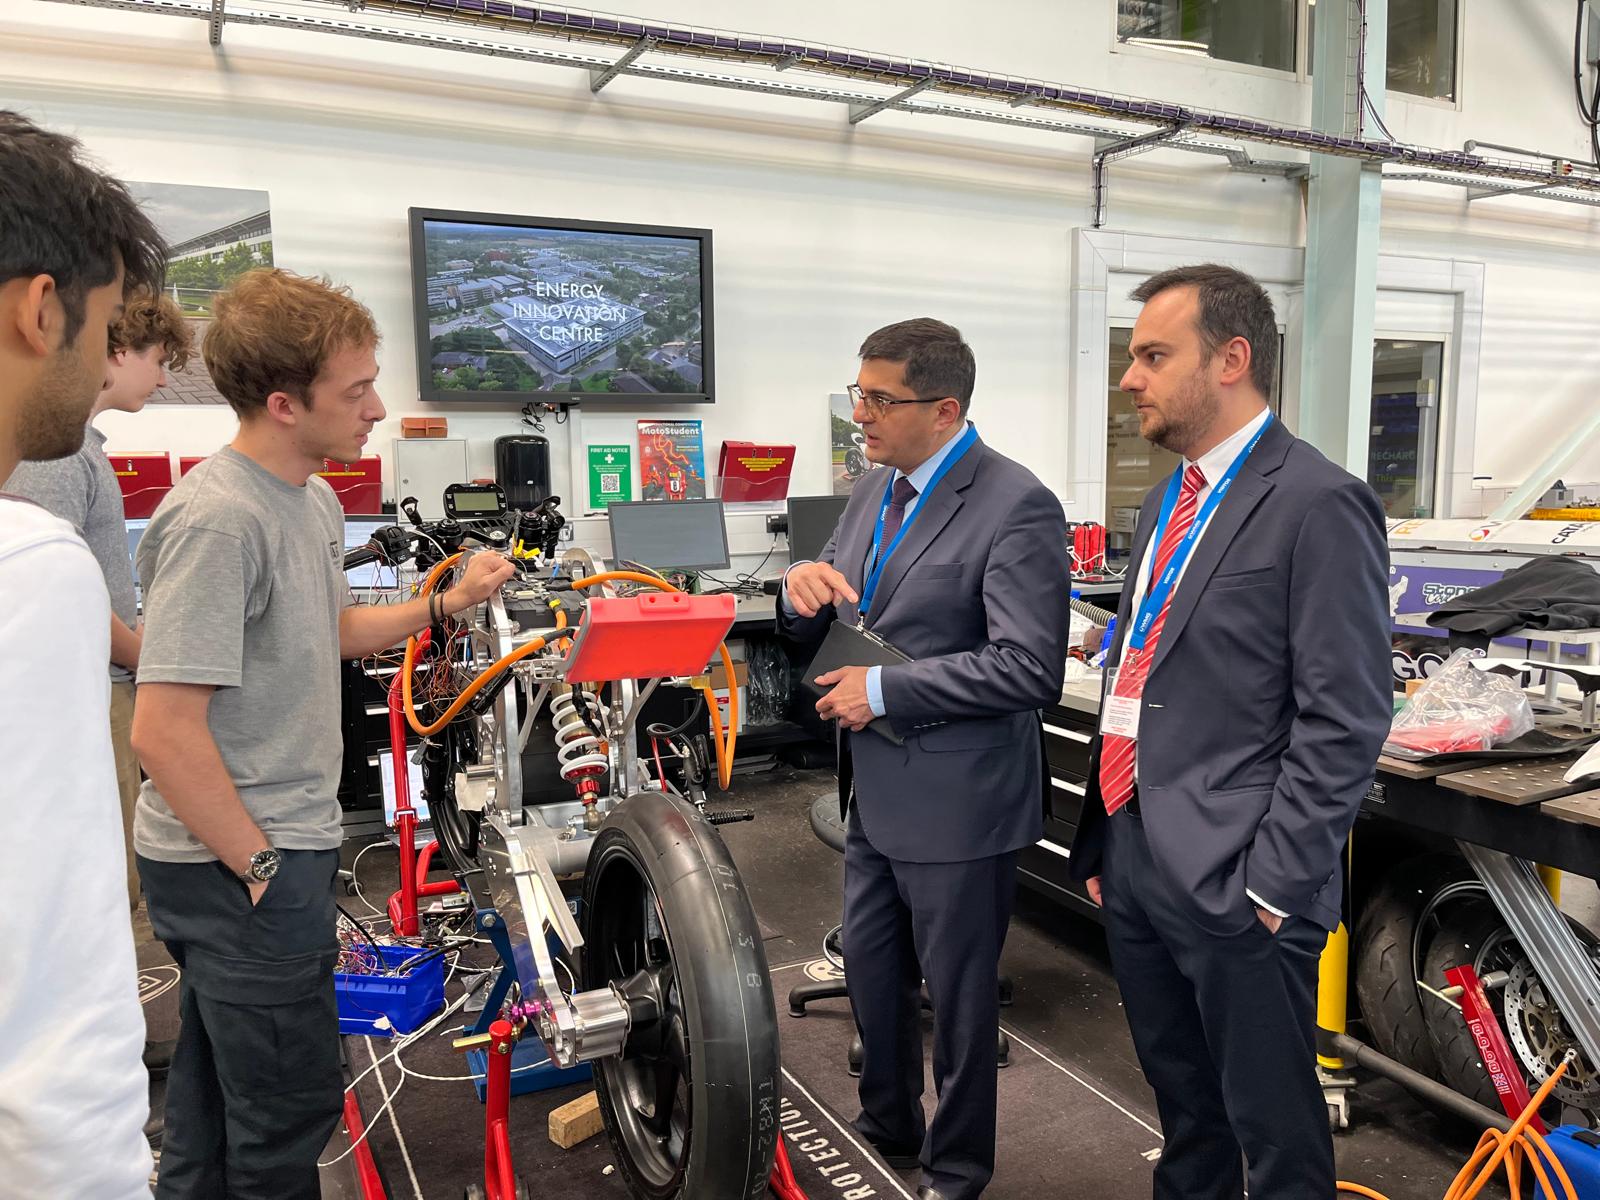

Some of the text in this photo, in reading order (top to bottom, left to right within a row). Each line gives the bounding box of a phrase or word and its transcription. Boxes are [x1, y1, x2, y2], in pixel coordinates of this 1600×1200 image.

[536, 281, 604, 299] ENERGY
[513, 303, 626, 322] INNOVATION
[540, 325, 603, 342] CENTRE
[641, 427, 700, 435] MotoStudent
[1217, 477, 1231, 494] VISITOR
[1163, 567, 1176, 584] VISITOR
[780, 1097, 884, 1200] ROTECTIO
